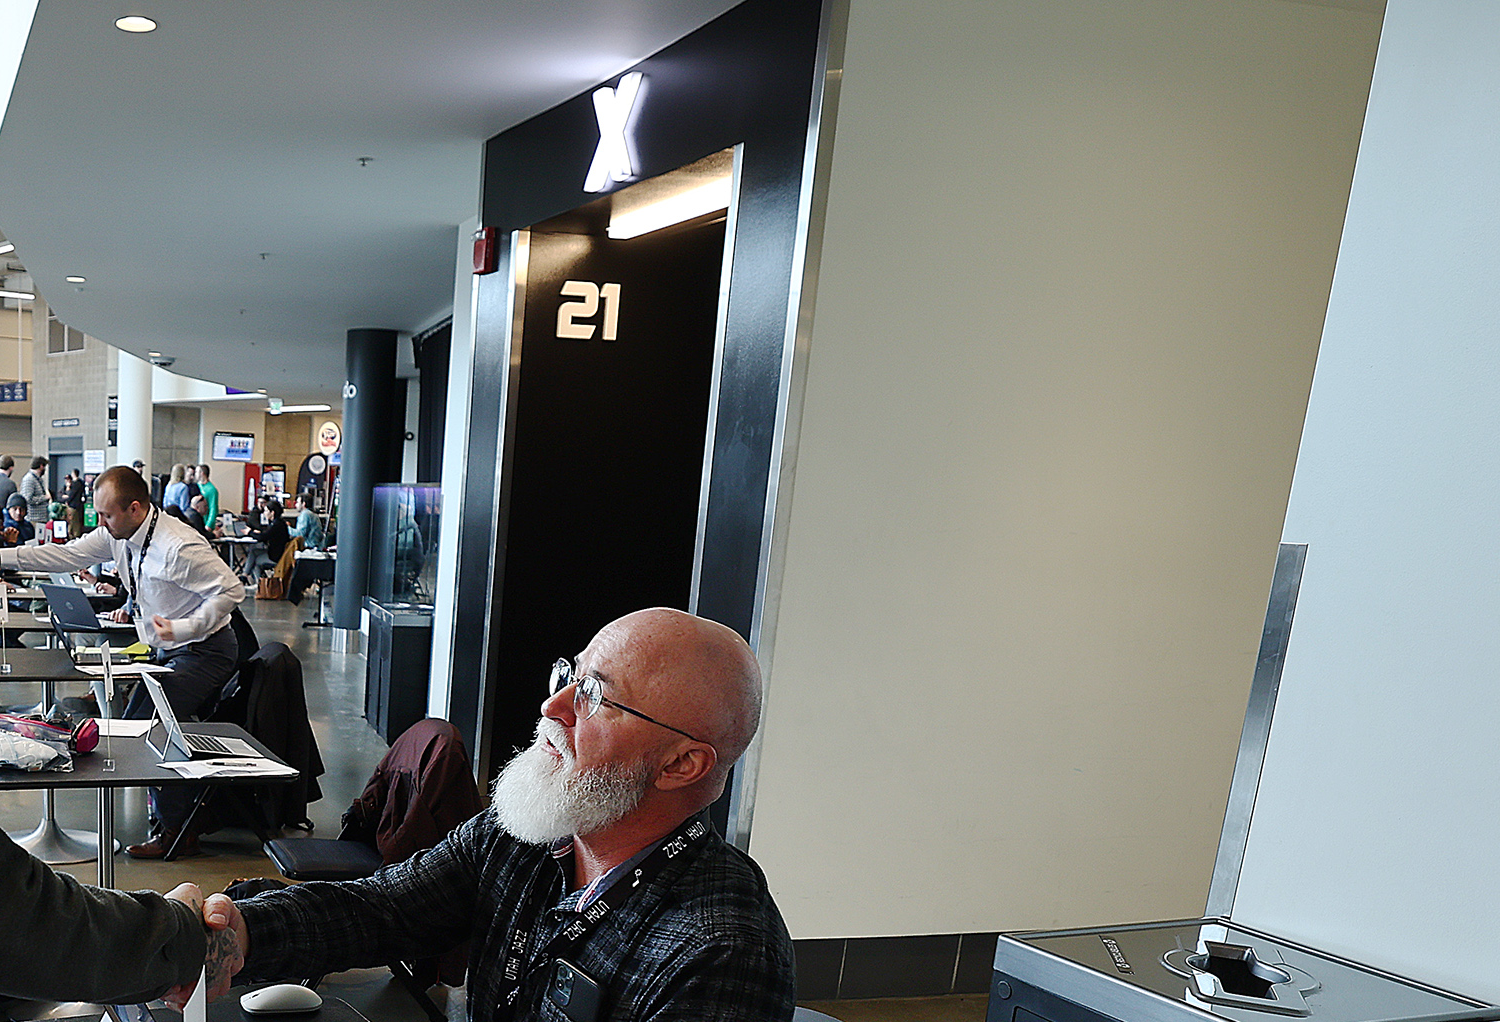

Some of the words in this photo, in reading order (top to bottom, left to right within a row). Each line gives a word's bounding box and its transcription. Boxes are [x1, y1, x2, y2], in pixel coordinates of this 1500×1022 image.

[556, 280, 621, 341] 21
[684, 820, 707, 841] UTAH
[662, 835, 688, 859] JAZZ
[583, 900, 610, 924] UTAH
[511, 929, 528, 954] JAZZ
[562, 920, 587, 941] JAZZ
[504, 956, 521, 981] UTAH
